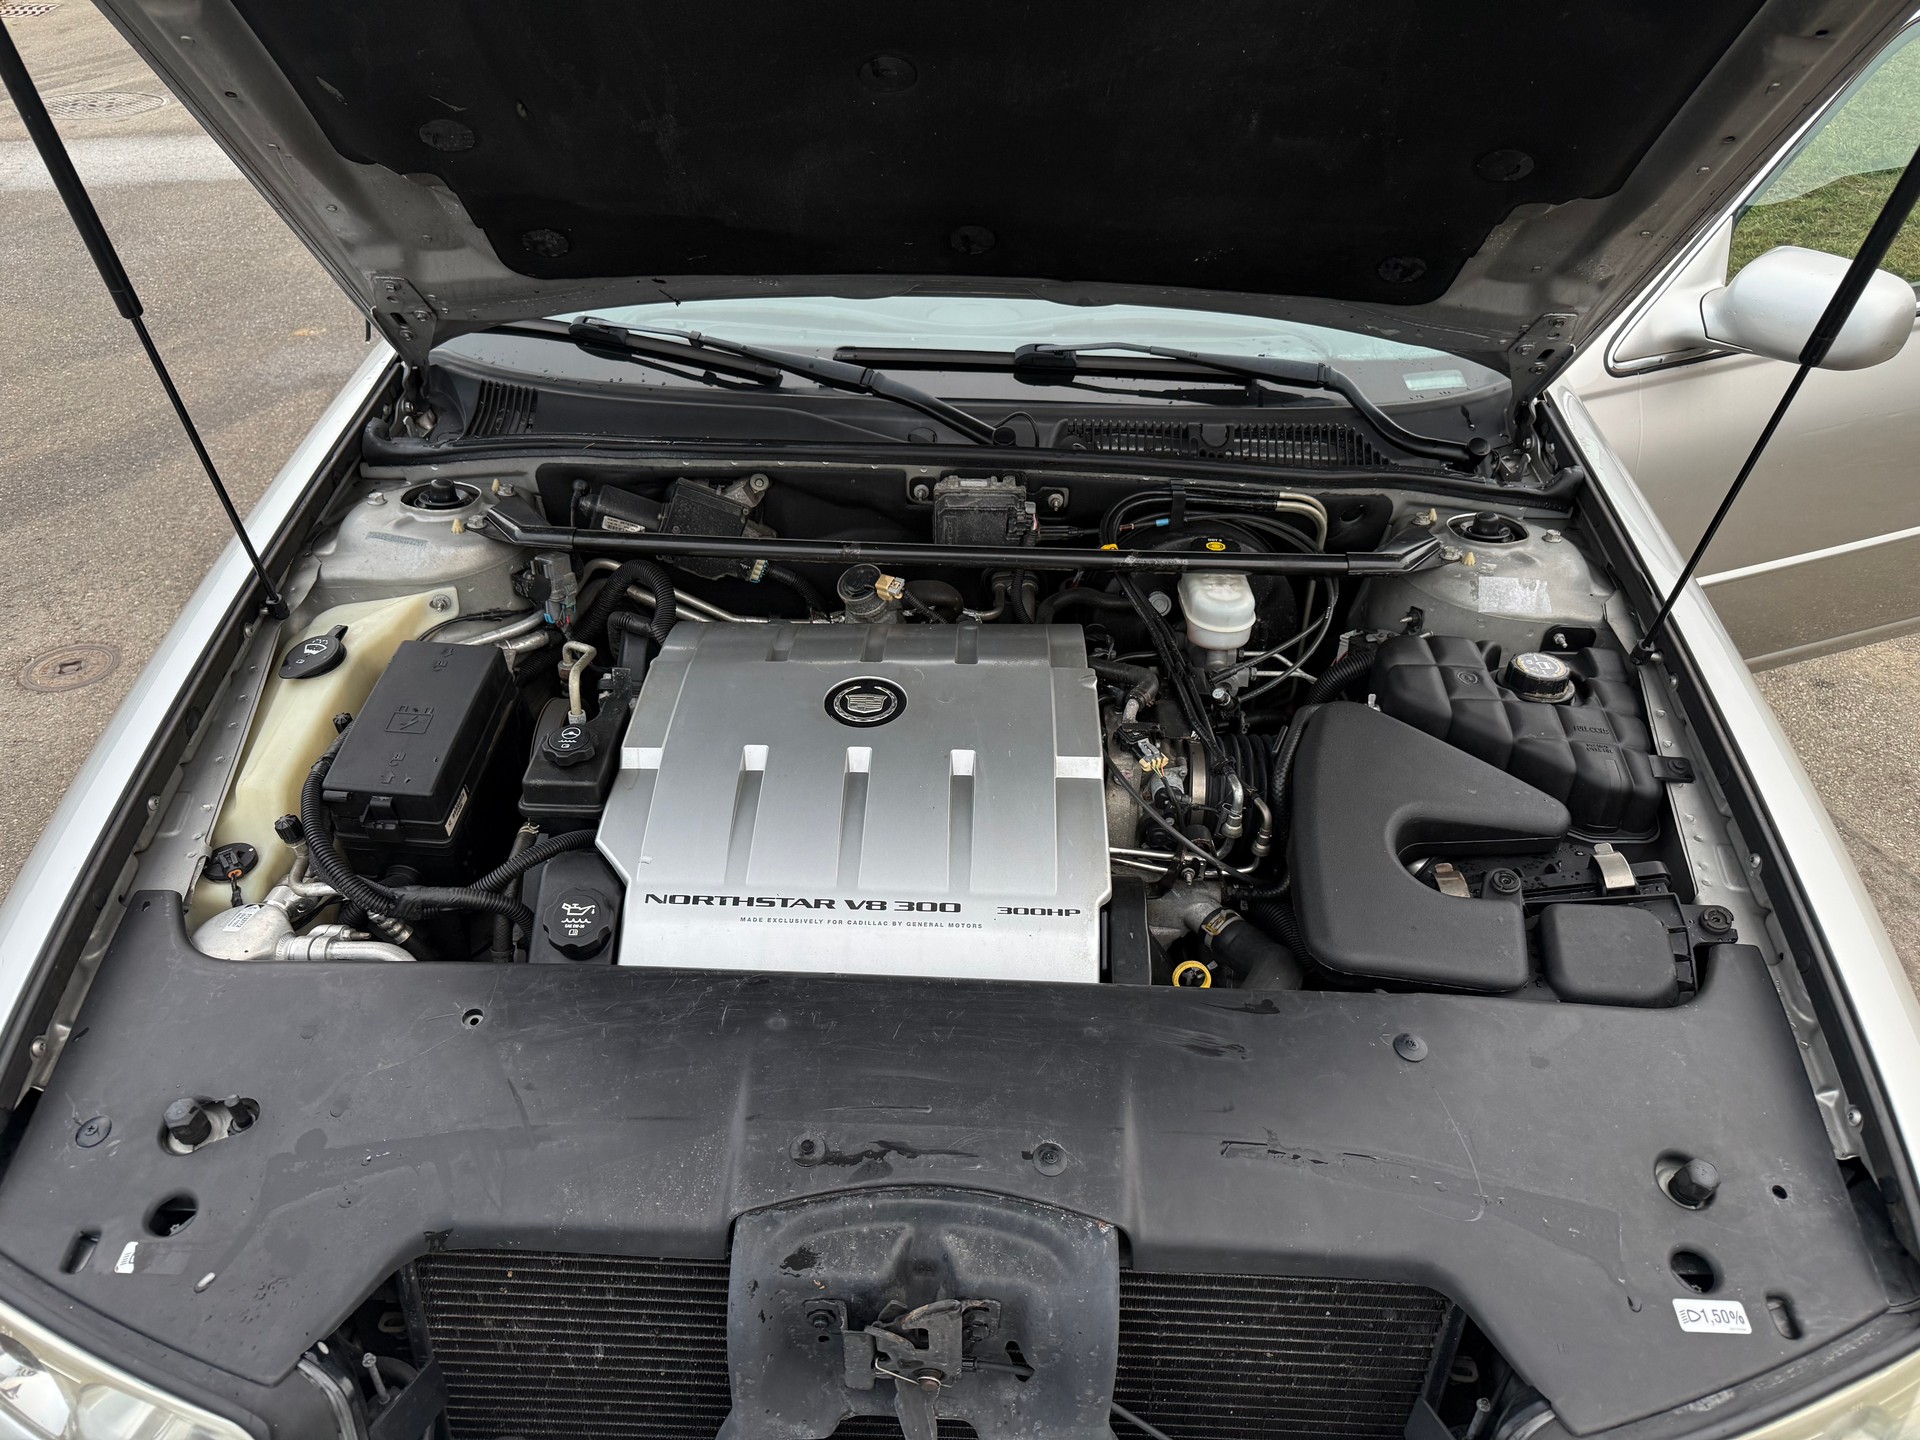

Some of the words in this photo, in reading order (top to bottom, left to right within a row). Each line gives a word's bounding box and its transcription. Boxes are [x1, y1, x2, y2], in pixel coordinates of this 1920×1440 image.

[645, 893, 836, 909] NORTHSTAR
[844, 899, 887, 911] V8
[894, 901, 961, 913] 300
[997, 906, 1081, 917] 300HP
[767, 917, 823, 925] EXCLUSIVELY
[847, 919, 888, 927] CADILLAC
[906, 921, 944, 929] GENERAL
[1700, 1308, 1745, 1326] 1,50%
